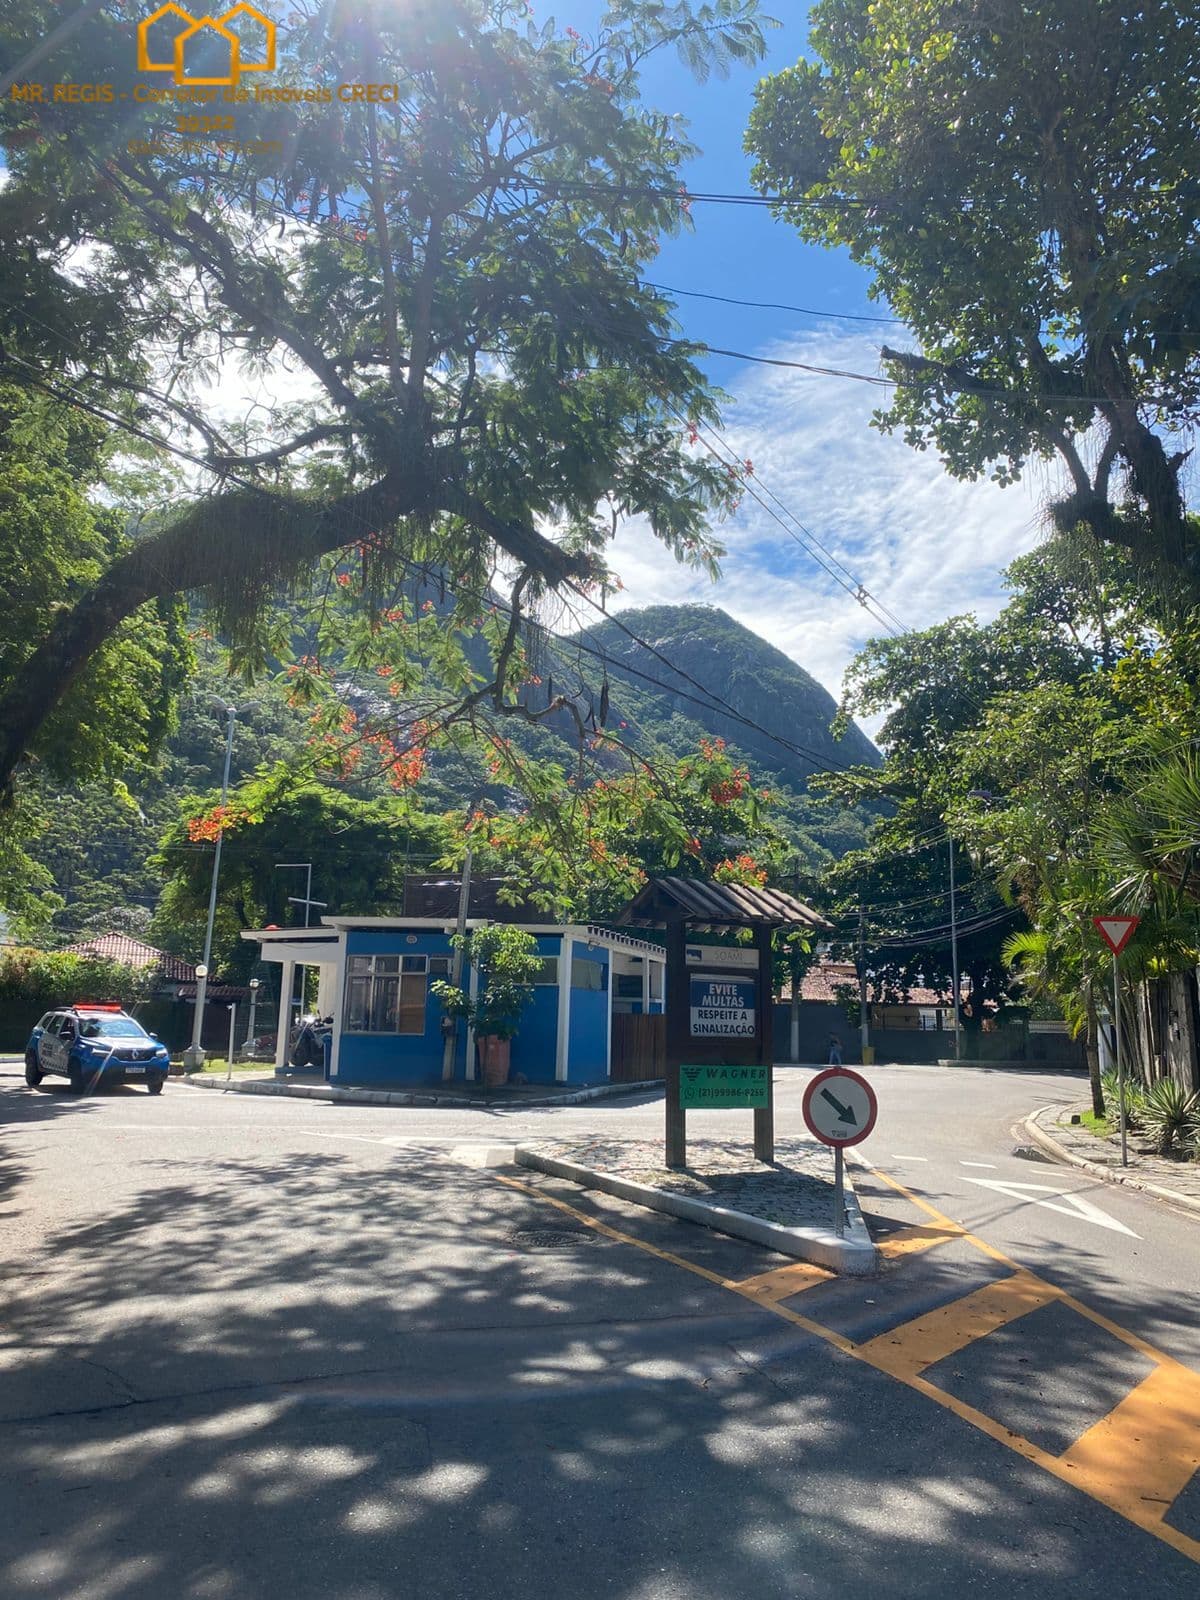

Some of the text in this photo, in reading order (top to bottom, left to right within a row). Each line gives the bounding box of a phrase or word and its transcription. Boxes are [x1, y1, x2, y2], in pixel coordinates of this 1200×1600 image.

[709, 983, 738, 996] EVITE
[701, 995, 745, 1008] MULTAS
[697, 1009, 738, 1020] RESPEITE
[692, 1022, 755, 1035] SINALIZAÇÃO
[706, 1067, 767, 1080] WAGNER
